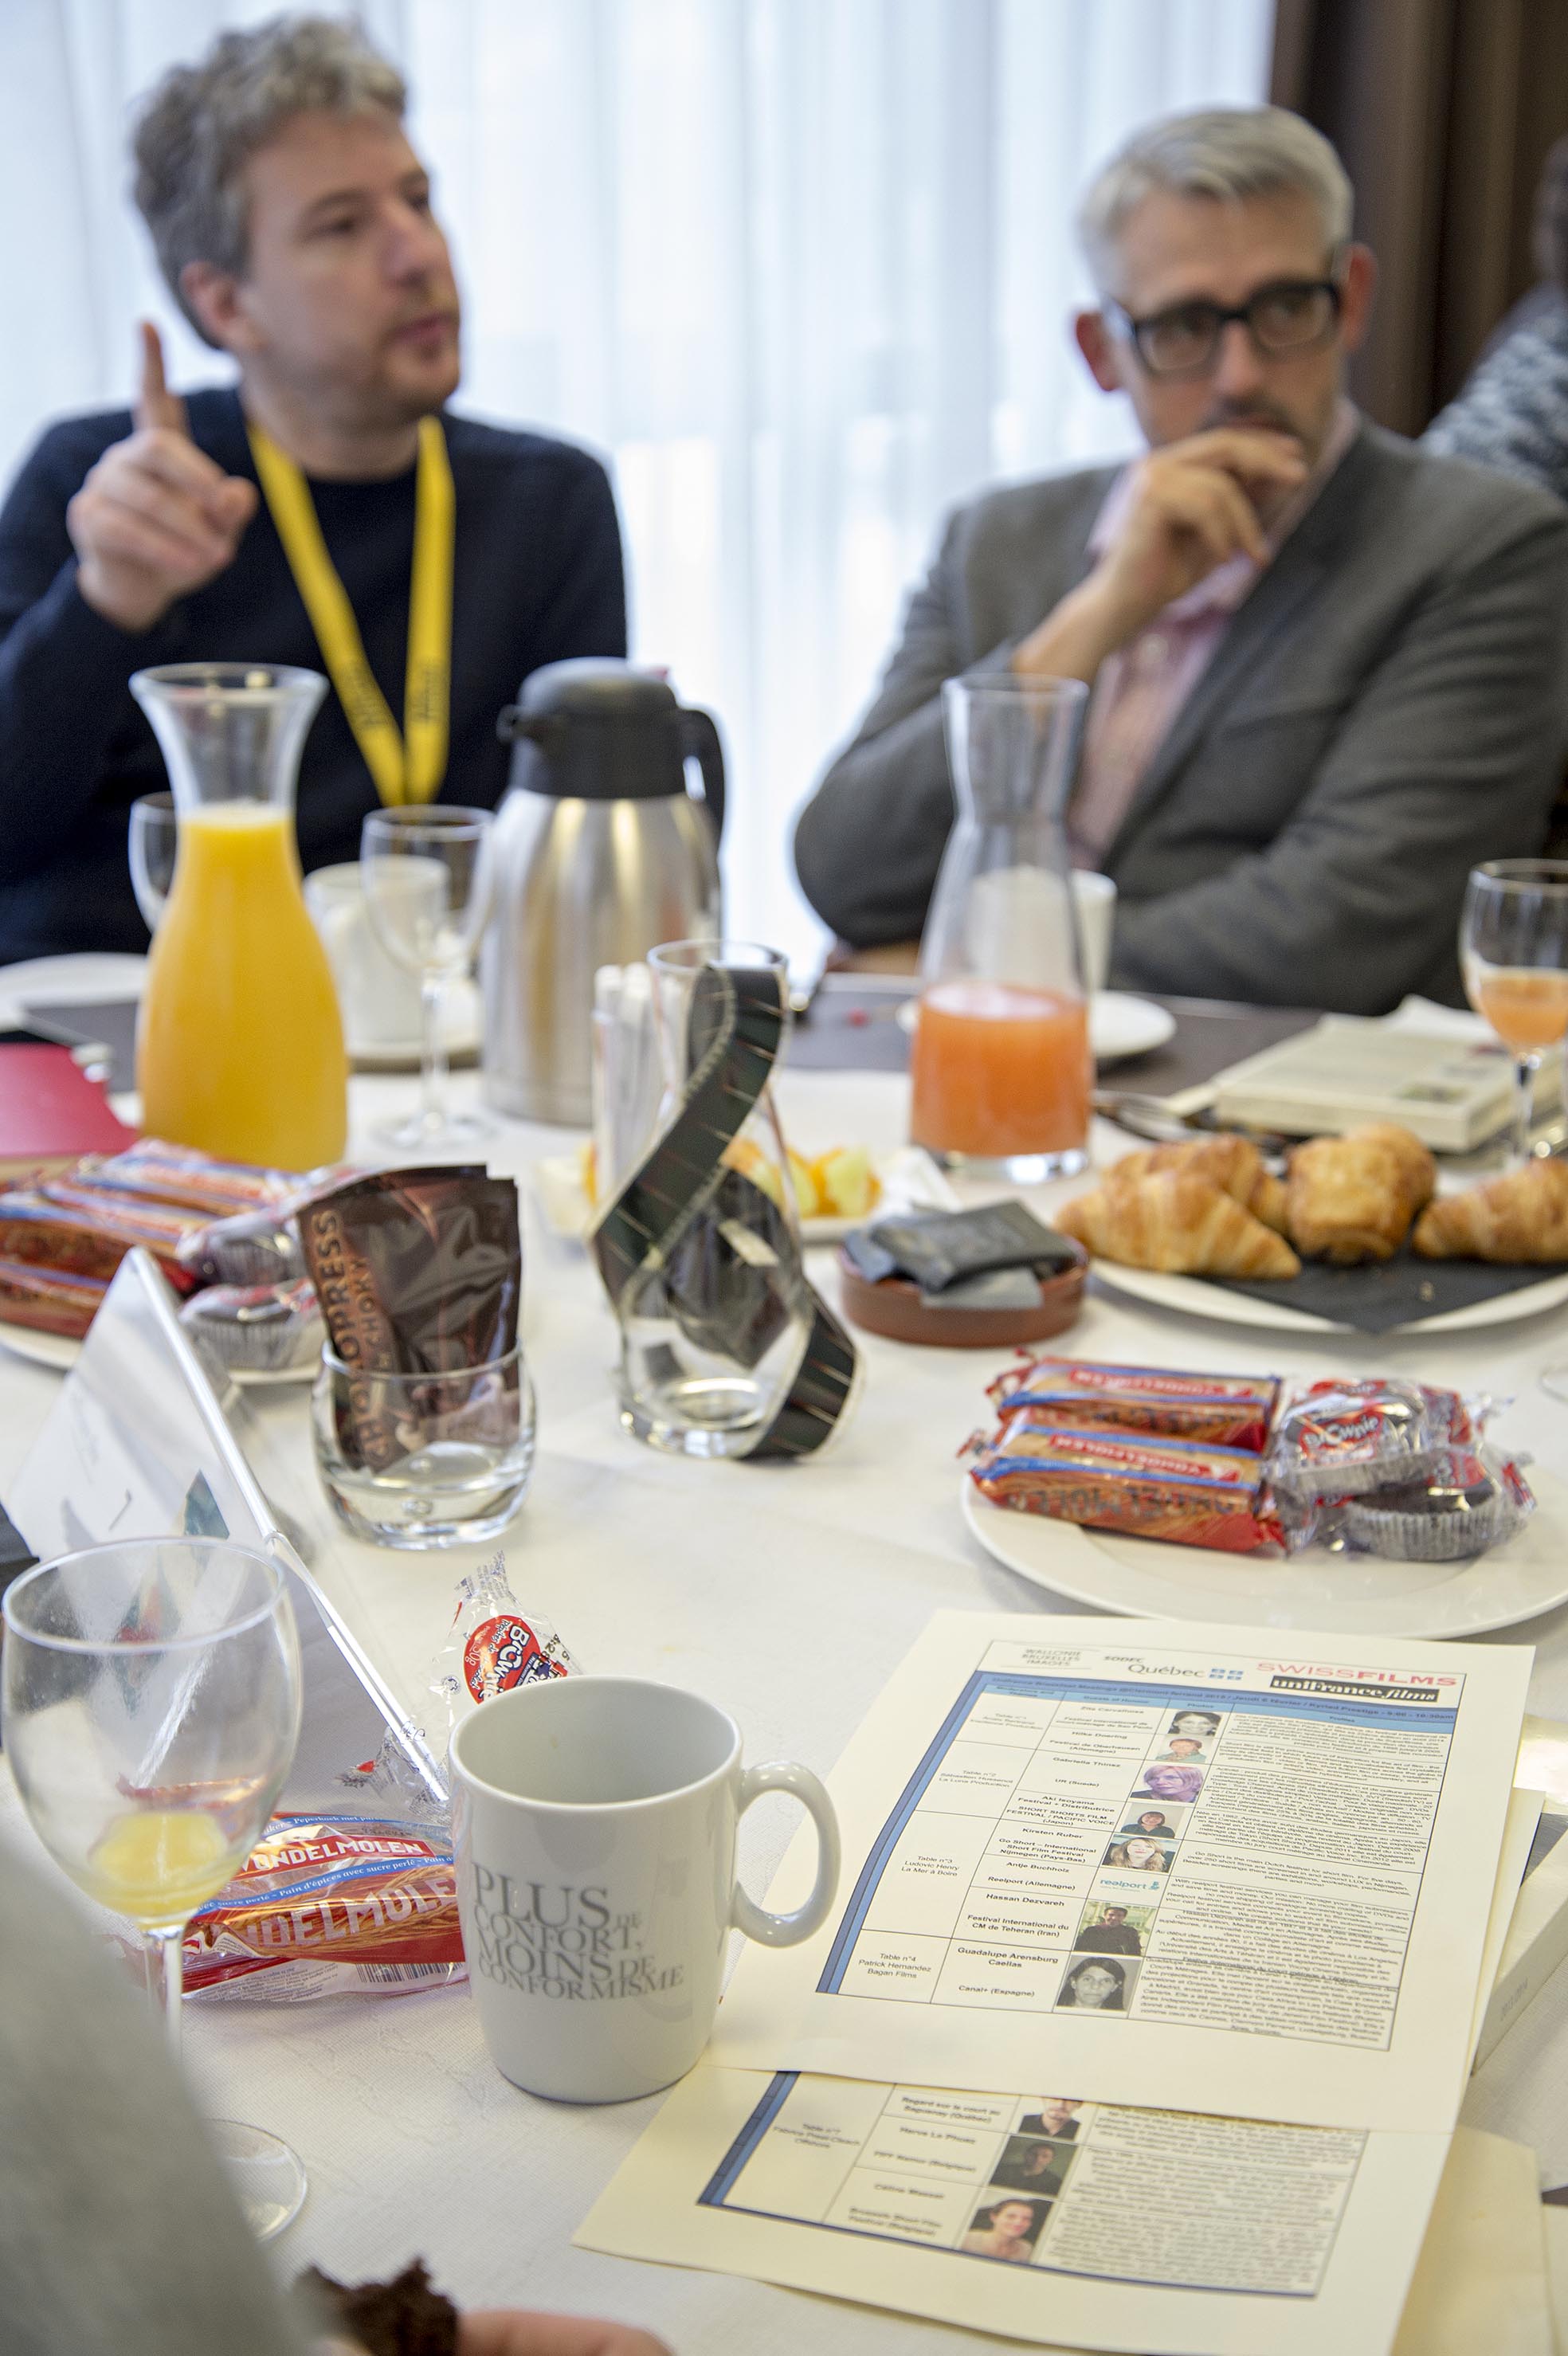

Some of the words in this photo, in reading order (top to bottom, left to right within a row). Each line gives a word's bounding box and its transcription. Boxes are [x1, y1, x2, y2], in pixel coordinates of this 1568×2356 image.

[477, 1624, 531, 1699] Brownie
[1127, 1662, 1205, 1678] Québec
[1256, 1663, 1457, 1686] SWISSFILMS
[1062, 1803, 1115, 1812] Distributrice
[1045, 1844, 1096, 1852] International
[1041, 1854, 1085, 1863] (Pays-Bas)
[198, 1902, 216, 1911] vec
[280, 1884, 303, 1897] Pain
[304, 1872, 341, 1890] d'épices
[343, 1868, 364, 1880] avec
[366, 1864, 391, 1874] sucre
[392, 1858, 416, 1871] perlé
[1025, 1881, 1075, 1890] (Allemagne)
[472, 1861, 612, 1930] PLUS
[1022, 1897, 1064, 1906] Dezvareh
[473, 1903, 644, 1954] CONFORT,
[1002, 1919, 1056, 1928] International
[477, 1928, 613, 1982] MOINS
[618, 1955, 654, 1979] DE
[958, 1947, 1007, 1958] Guadalupe
[1009, 1954, 1058, 1963] Arensburg
[888, 1962, 931, 1971] Hernandez
[478, 1958, 685, 2001] CONFORMISME
